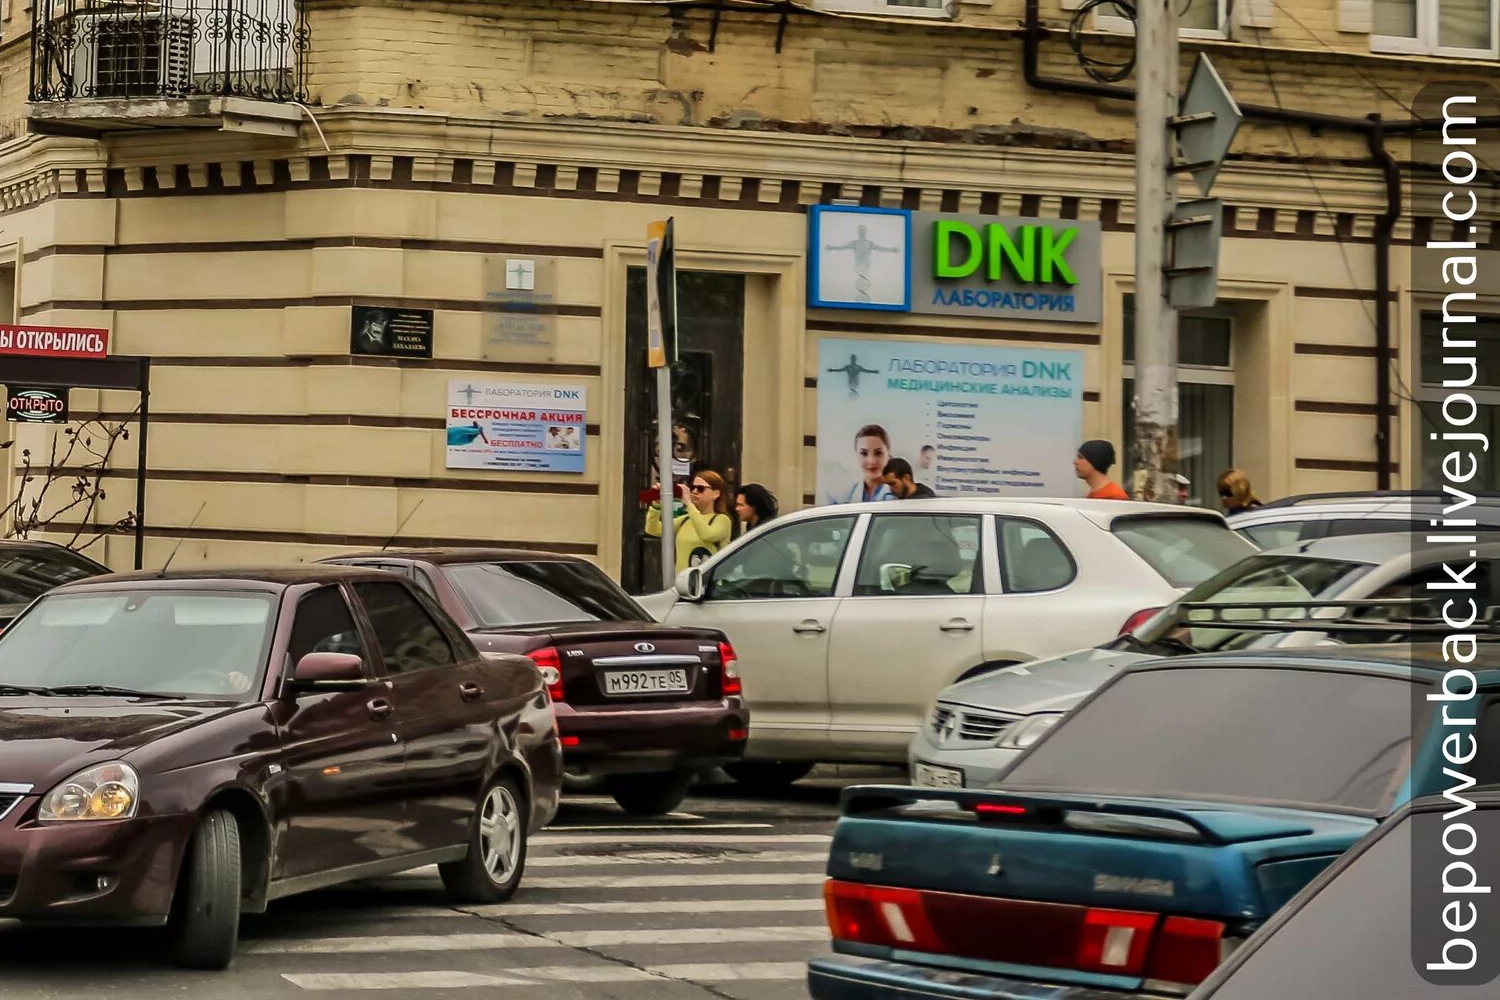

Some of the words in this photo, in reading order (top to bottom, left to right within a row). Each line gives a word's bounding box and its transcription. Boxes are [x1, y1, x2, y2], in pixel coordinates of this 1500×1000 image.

[933, 219, 1080, 286] DNK
[932, 287, 1076, 312] ЛАБОРАТОРИЯ
[16, 331, 104, 352] ОТКРЫЛИСЬ
[887, 358, 1017, 377] ЛАБОРАТОРИЯ
[1022, 360, 1072, 381] DNK
[485, 387, 551, 398] ЛАБОРАТОРИЯ
[554, 389, 580, 400] DNK
[887, 377, 998, 395] МЕДИЦИНСКИЕ
[1001, 382, 1072, 398] АНАЛИЗЫ
[10, 397, 64, 412] ОТКРЫТО
[451, 408, 536, 421] БЕССРОЧНАЯ
[540, 412, 583, 424] АКЦИЯ
[490, 439, 543, 449] БЕСПЛАТНО
[669, 671, 682, 683] 05
